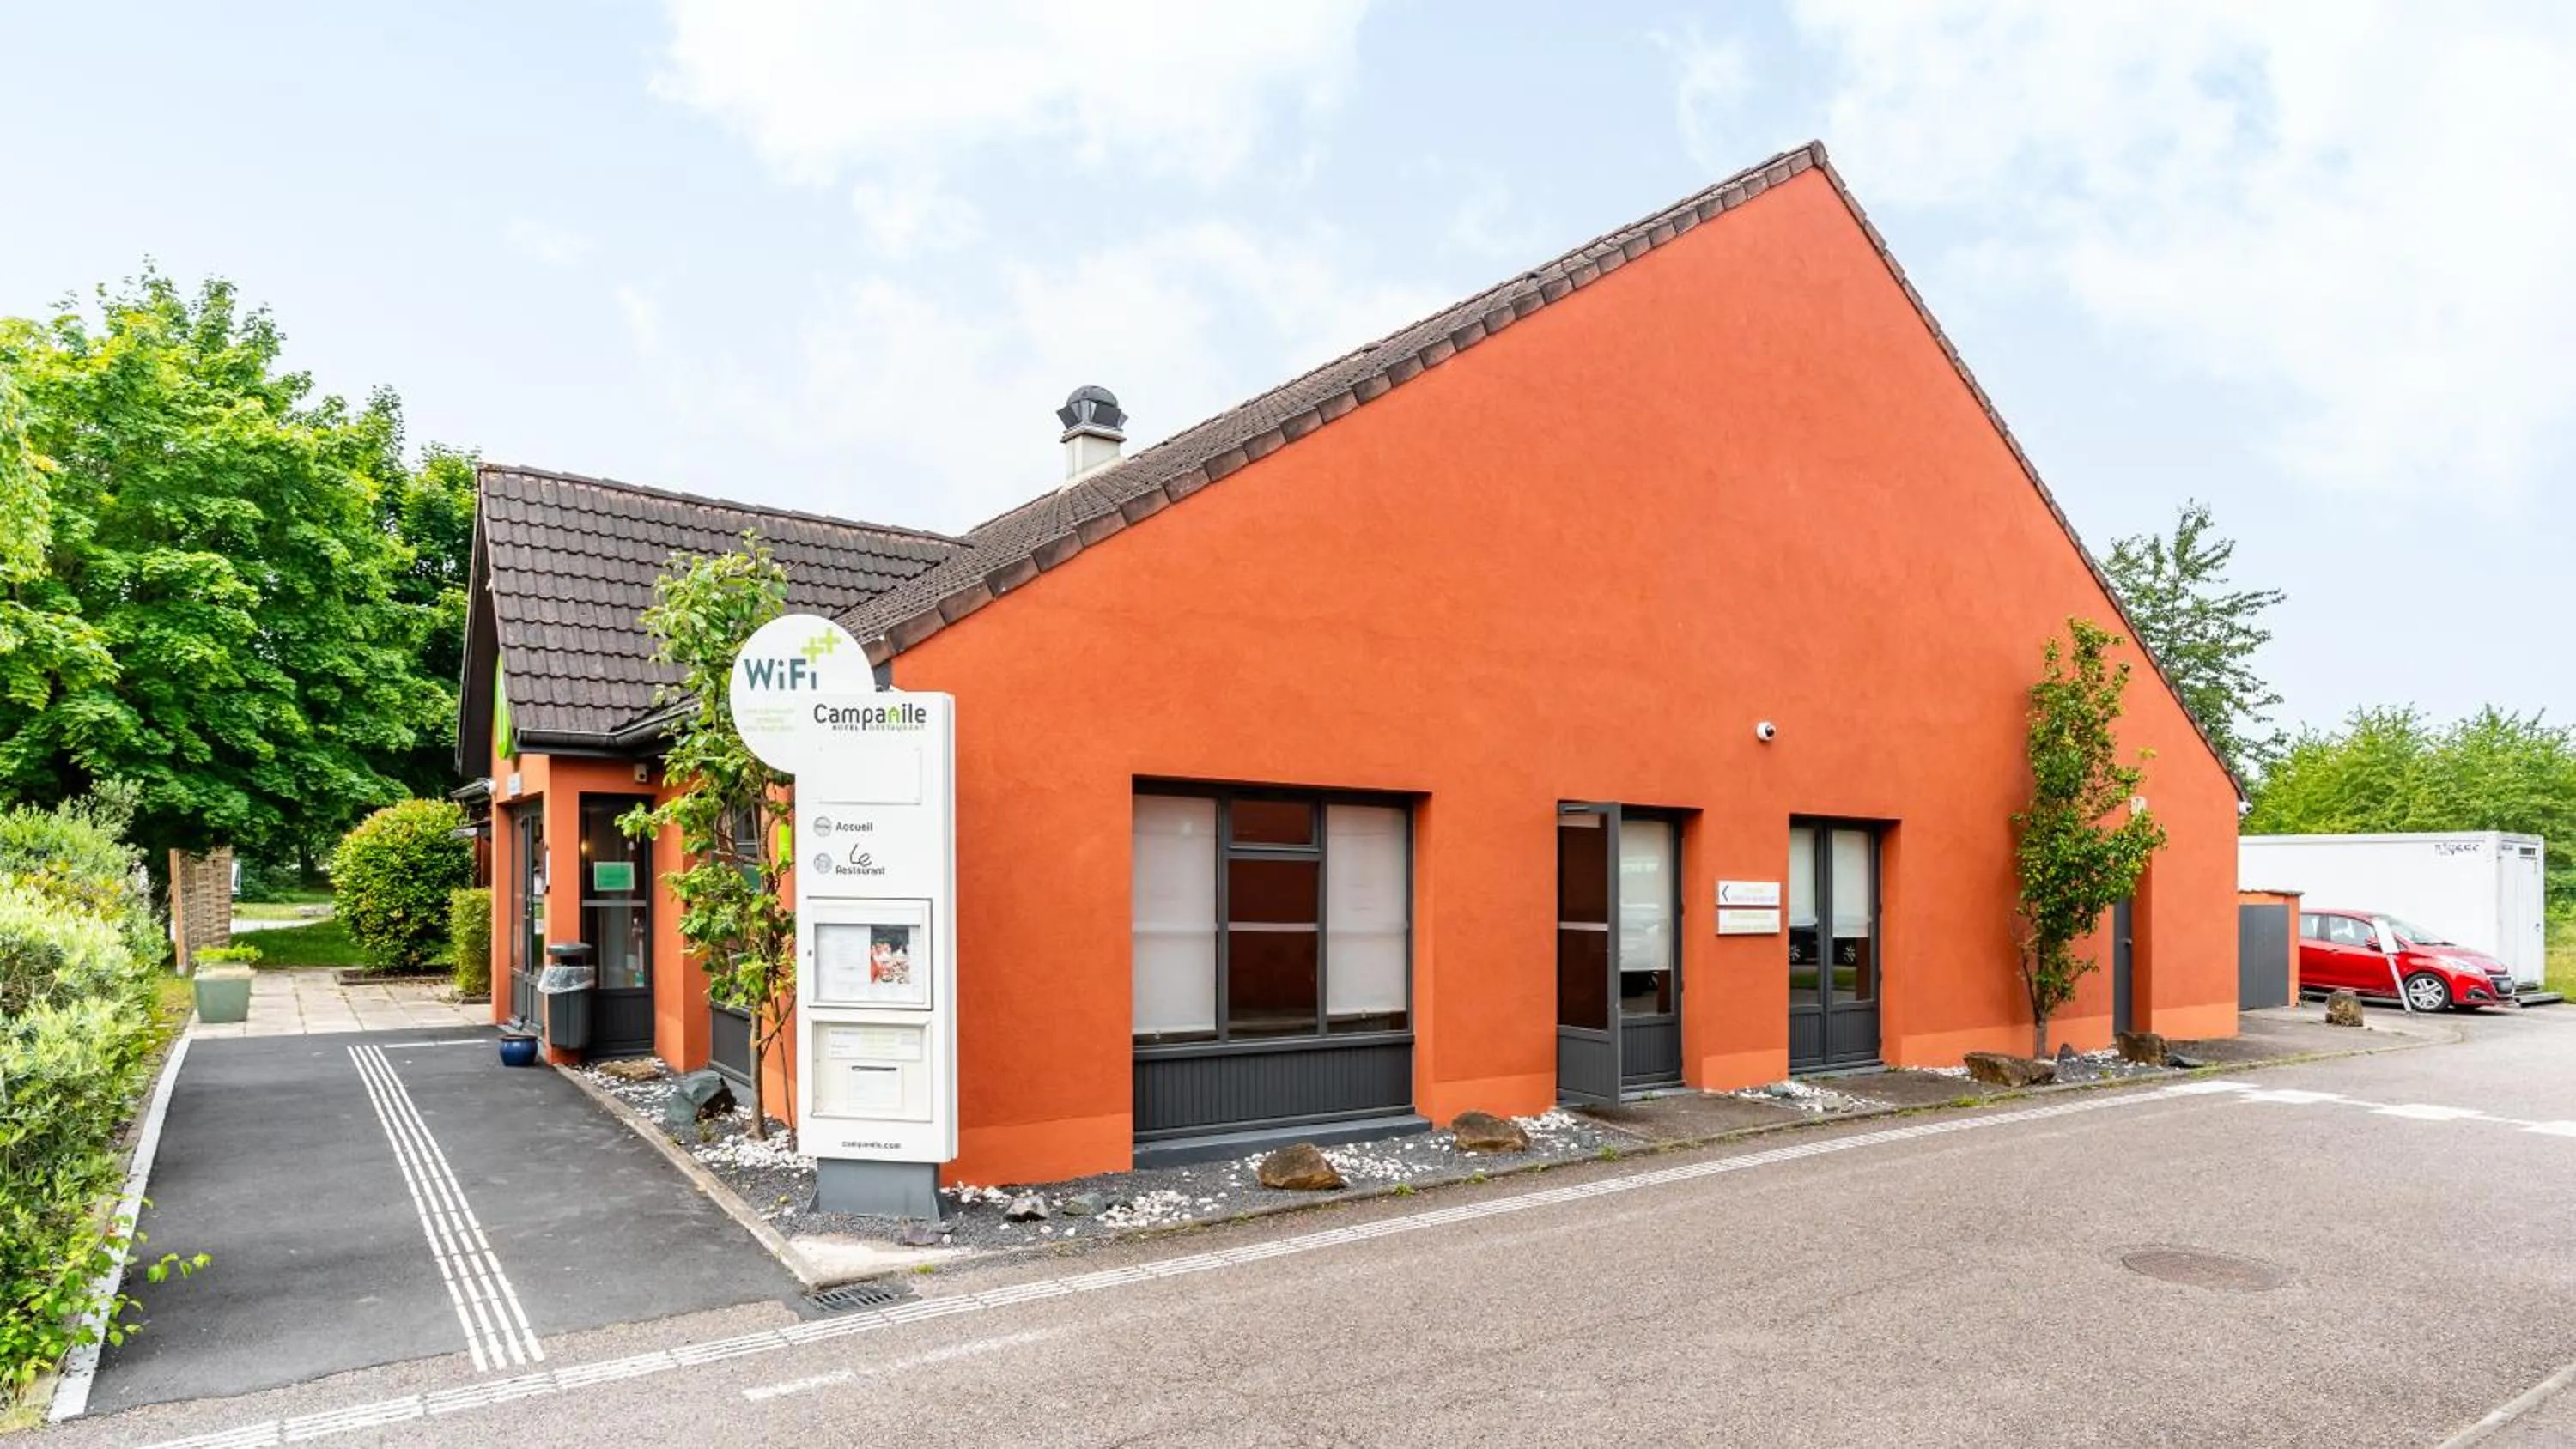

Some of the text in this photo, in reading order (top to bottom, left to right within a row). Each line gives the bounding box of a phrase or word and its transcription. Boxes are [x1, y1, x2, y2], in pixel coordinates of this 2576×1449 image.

[813, 703, 927, 731] Campanile
[835, 822, 873, 831] Accueil
[849, 842, 872, 867] Le
[835, 864, 885, 876] Restaurant
